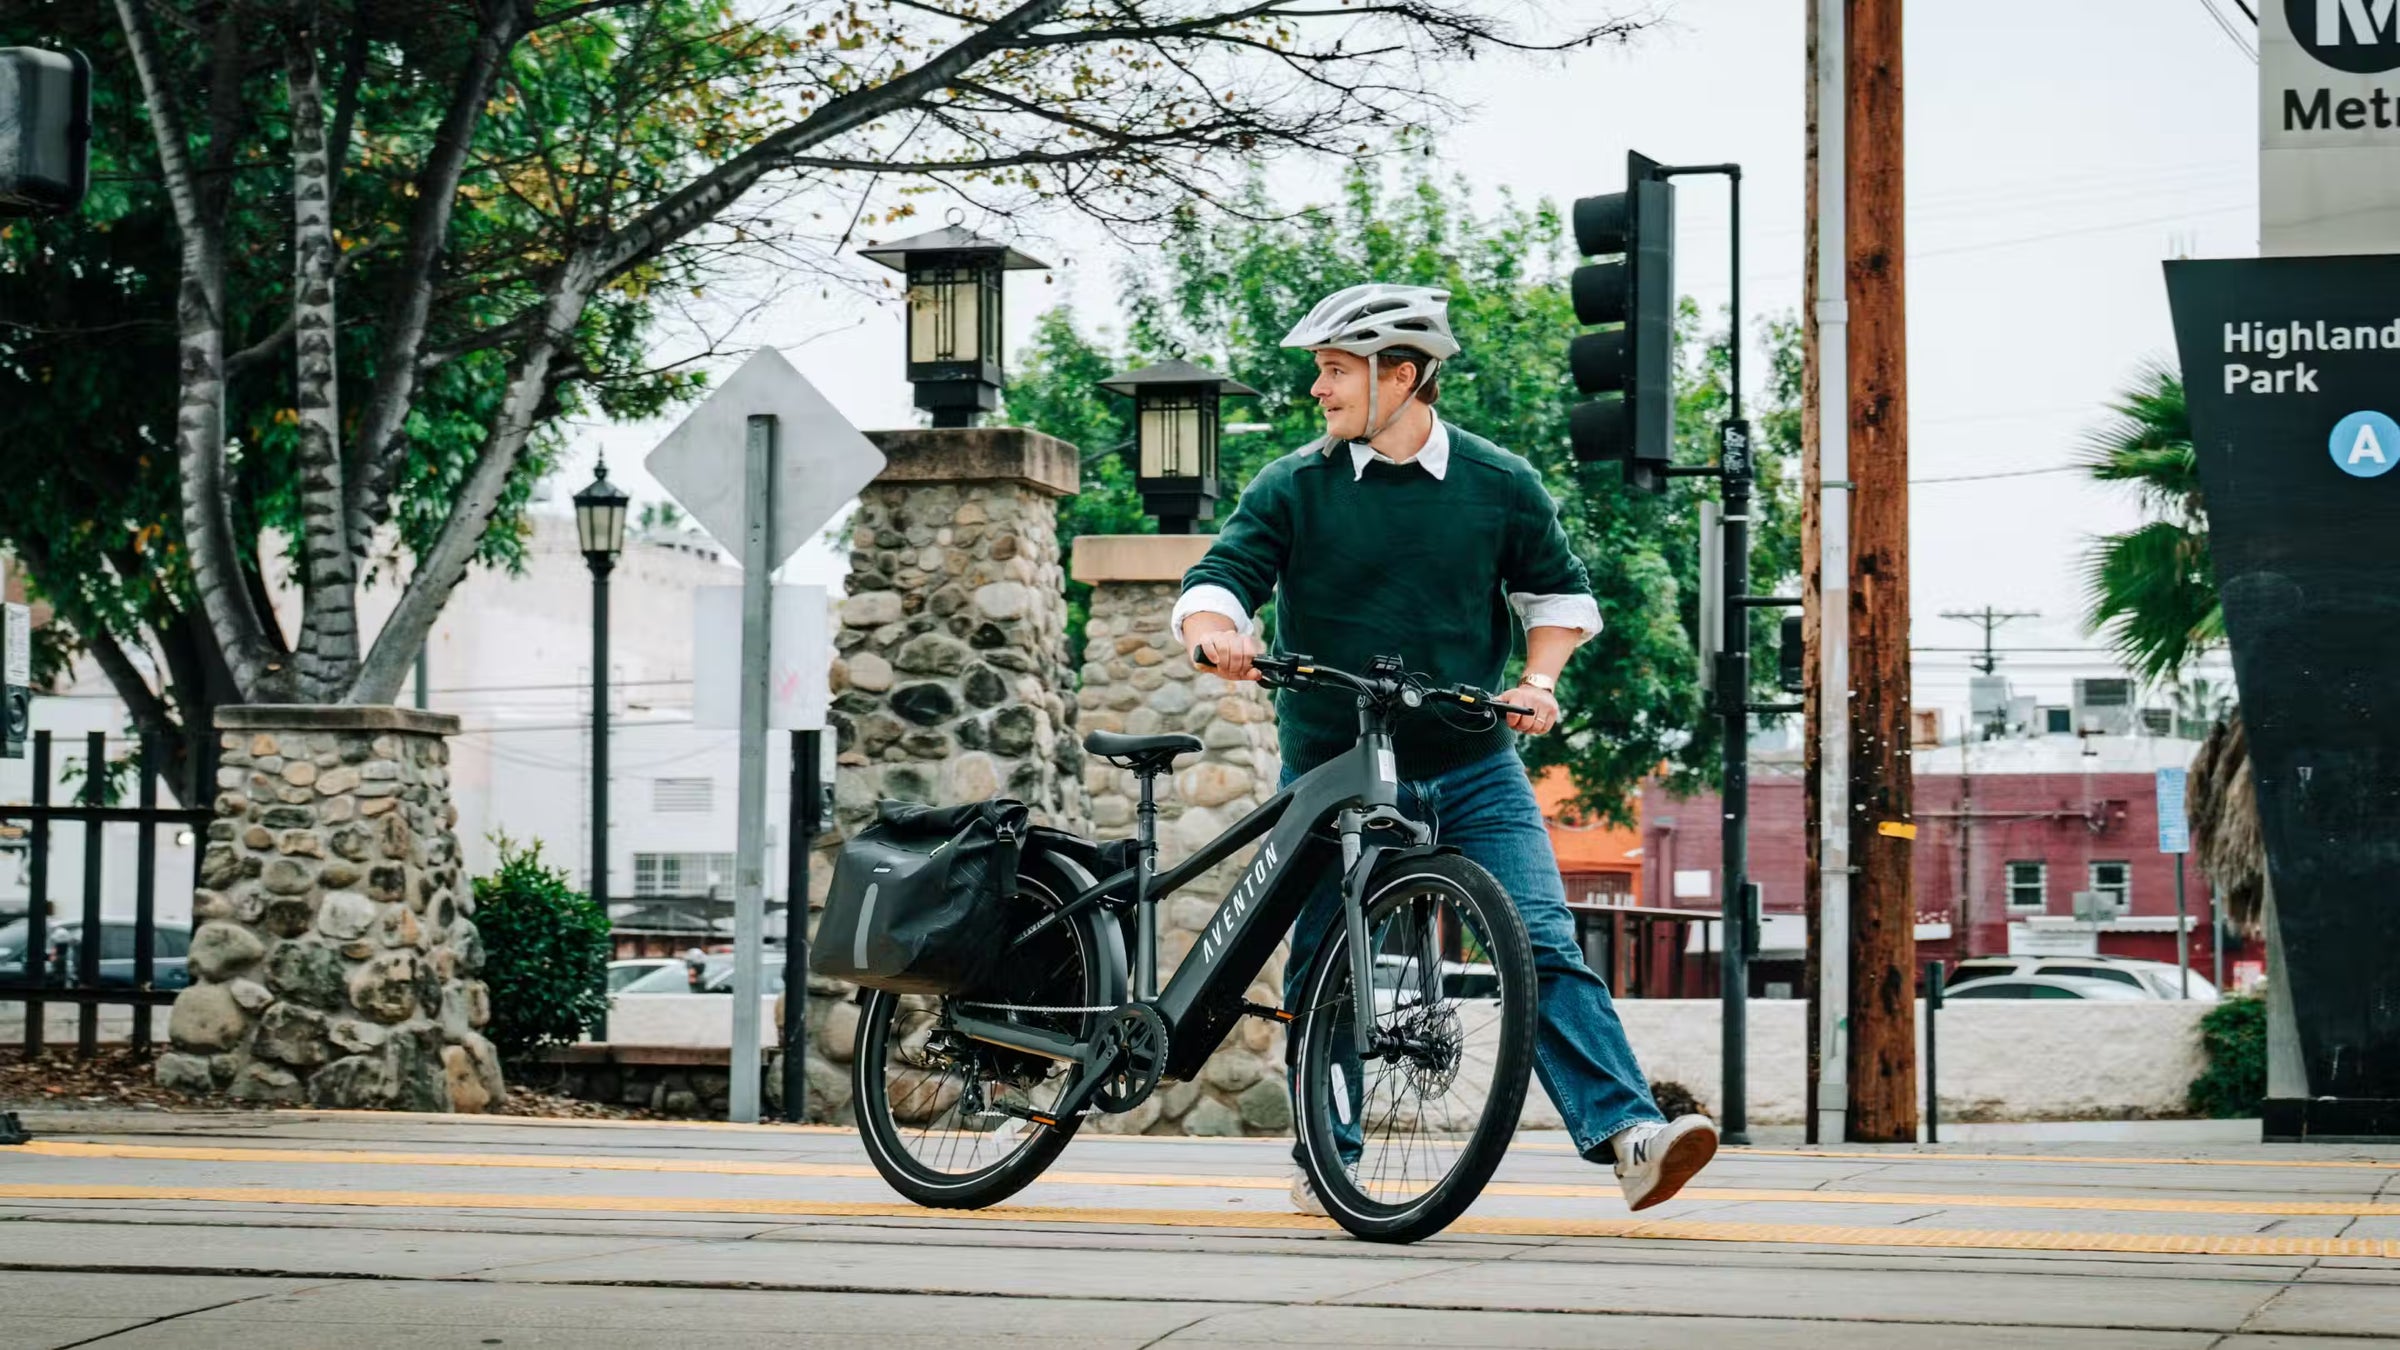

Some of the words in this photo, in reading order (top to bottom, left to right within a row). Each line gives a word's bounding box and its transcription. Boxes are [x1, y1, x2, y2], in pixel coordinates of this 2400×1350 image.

[2284, 88, 2400, 130] Met
[2224, 318, 2400, 359] Highland
[2224, 362, 2319, 394] Park
[2347, 424, 2387, 464] A
[1203, 842, 1278, 963] AVENTON
[1634, 1138, 1647, 1166] N
